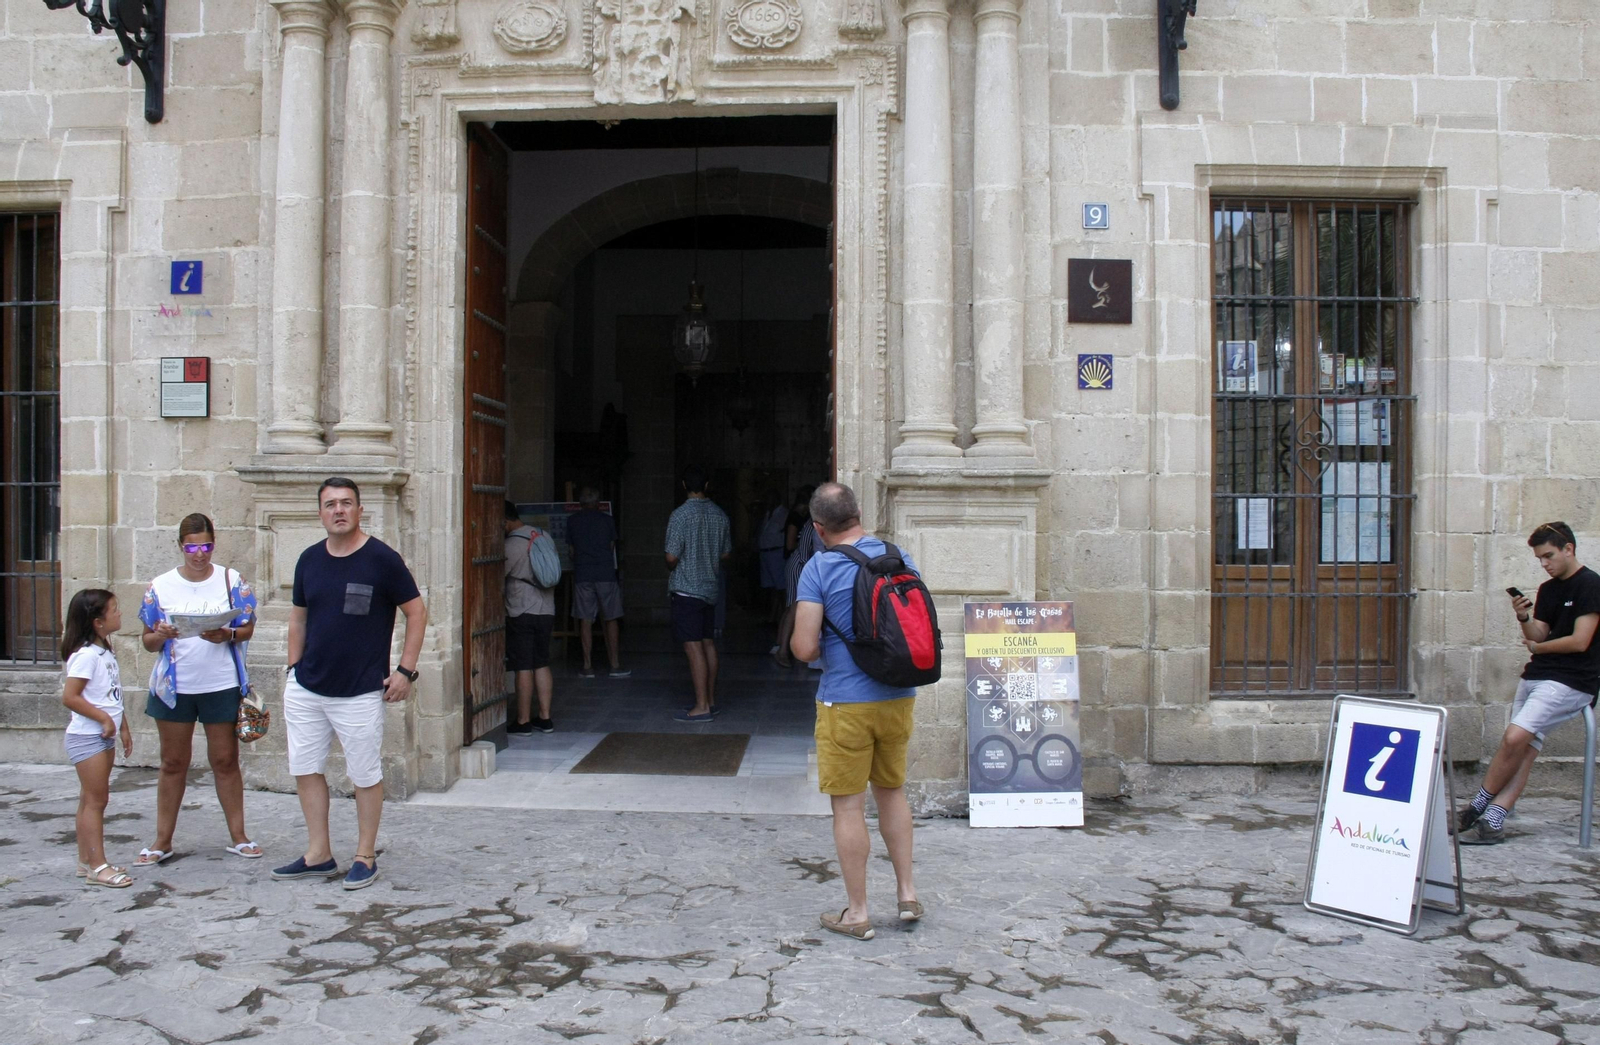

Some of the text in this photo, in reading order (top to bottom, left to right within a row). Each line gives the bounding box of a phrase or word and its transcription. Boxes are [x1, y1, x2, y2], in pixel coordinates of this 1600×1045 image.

[749, 7, 781, 22] 1660
[1089, 206, 1102, 225] 9
[1014, 606, 1023, 617] de
[1025, 607, 1036, 618] las
[1007, 647, 1037, 655] DESCUENTO
[1364, 730, 1402, 792] i
[1329, 815, 1411, 851] Andalucía
[1366, 846, 1385, 854] OFICINAS
[1392, 850, 1411, 859] TURISMO
